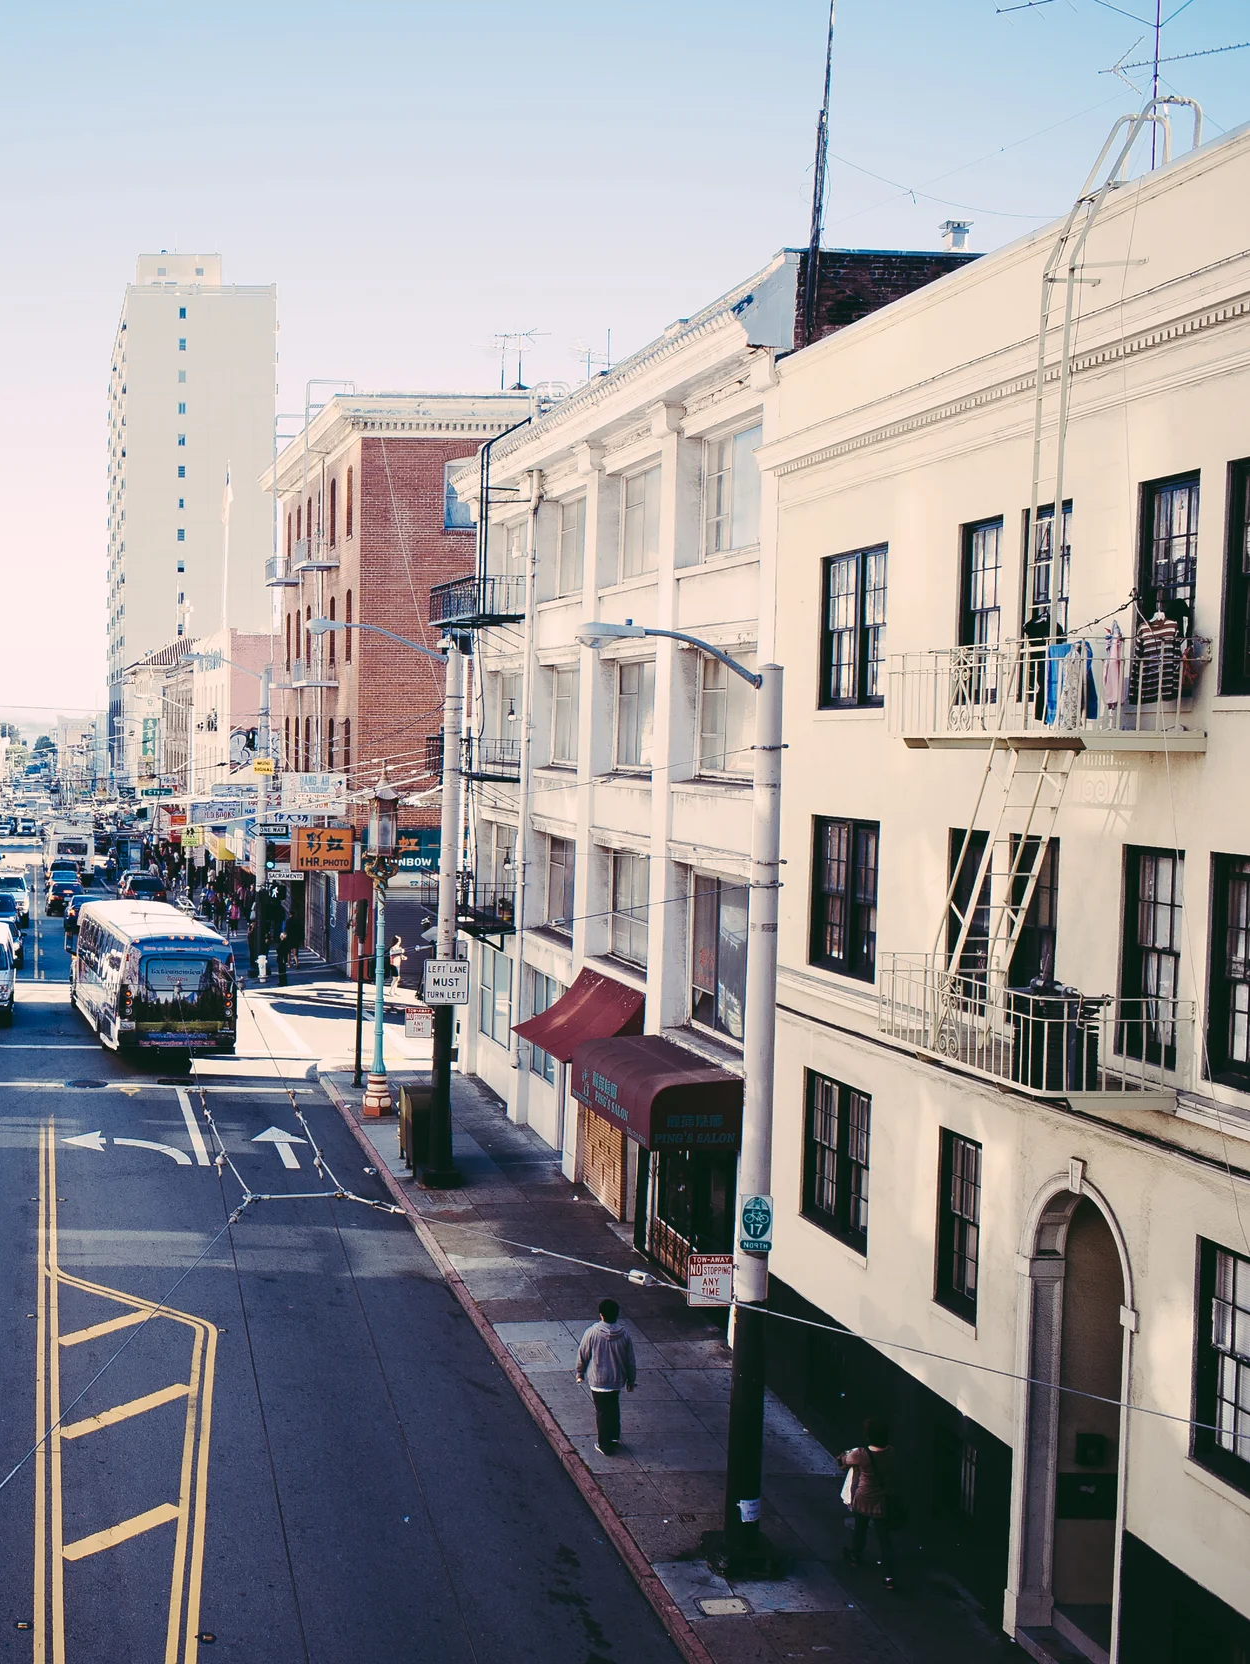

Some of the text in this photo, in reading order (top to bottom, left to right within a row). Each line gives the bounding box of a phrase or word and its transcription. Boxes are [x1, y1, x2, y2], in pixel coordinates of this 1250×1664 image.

[215, 811, 235, 819] BOOKS
[306, 831, 345, 855] 彩虹
[323, 859, 349, 867] PHOTO
[427, 965, 467, 974] LEFT LANE
[432, 978, 460, 987] MUST
[427, 991, 466, 999] TURN LEFT
[594, 1090, 611, 1110] PING'S
[611, 1101, 629, 1122] SALON
[654, 1131, 693, 1144] PING'S
[696, 1133, 737, 1144] SALON
[750, 1224, 763, 1235] 17
[743, 1241, 768, 1249] NORTH
[693, 1256, 730, 1264] TOW-AWAY
[690, 1263, 731, 1275] NO STOPPING
[702, 1278, 720, 1286] ANY
[701, 1287, 720, 1296] TIME
